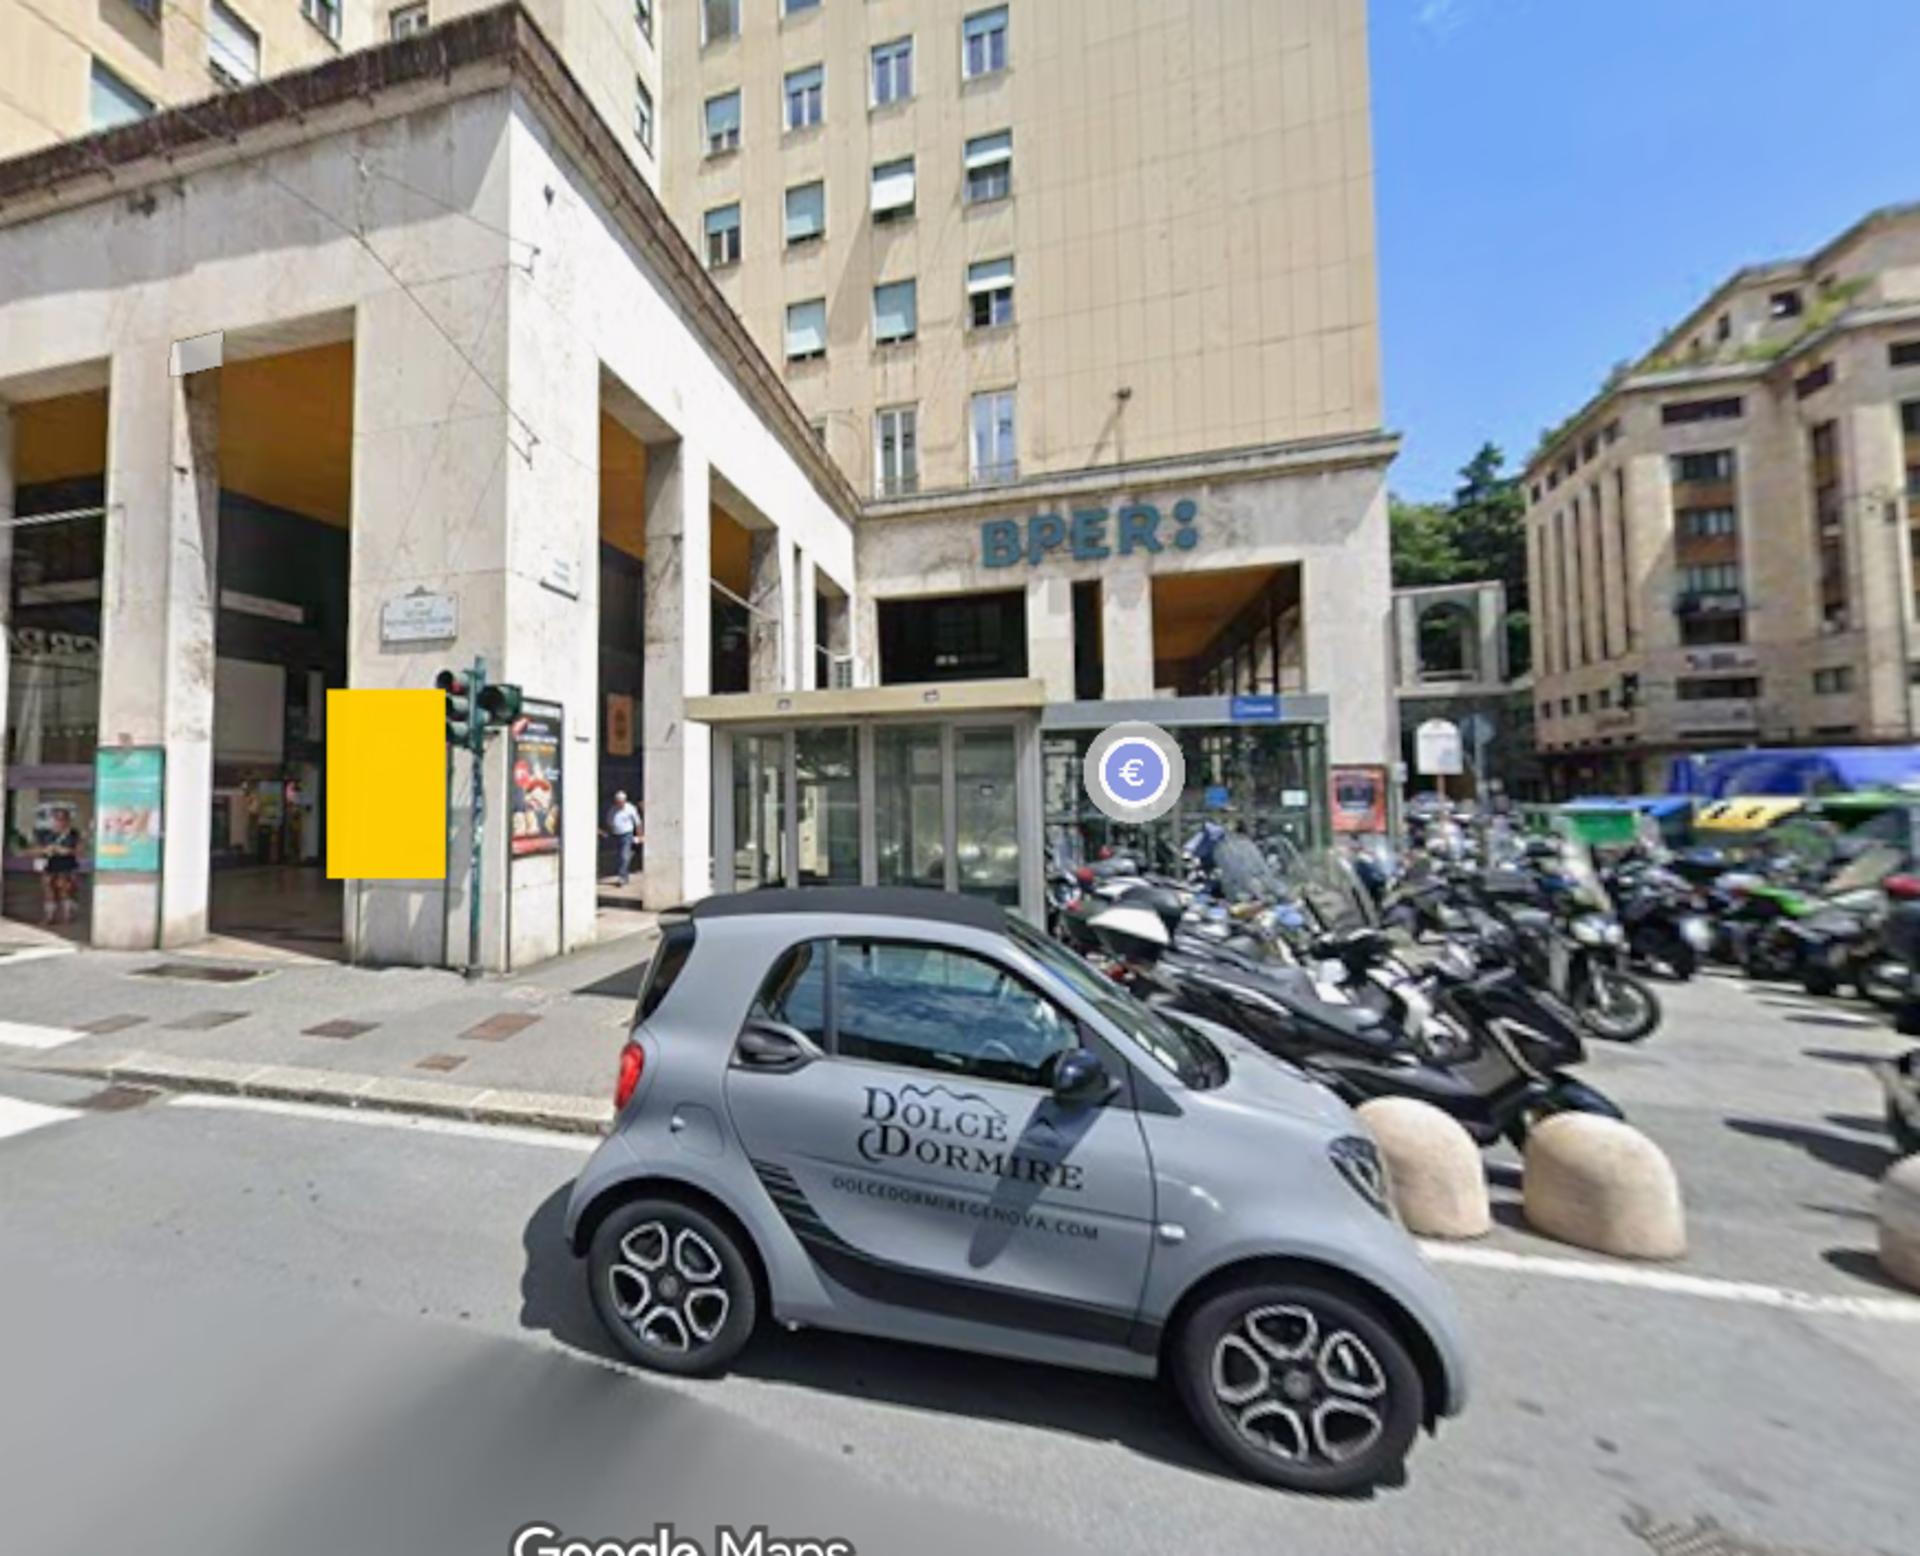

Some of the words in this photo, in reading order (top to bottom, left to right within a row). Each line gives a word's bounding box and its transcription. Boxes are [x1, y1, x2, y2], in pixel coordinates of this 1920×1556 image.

[861, 1086, 1009, 1142] DOLCE
[858, 1123, 1084, 1191] DORMIRE
[831, 1175, 1099, 1240] DOLCEDORMIREGENOVA.COM
